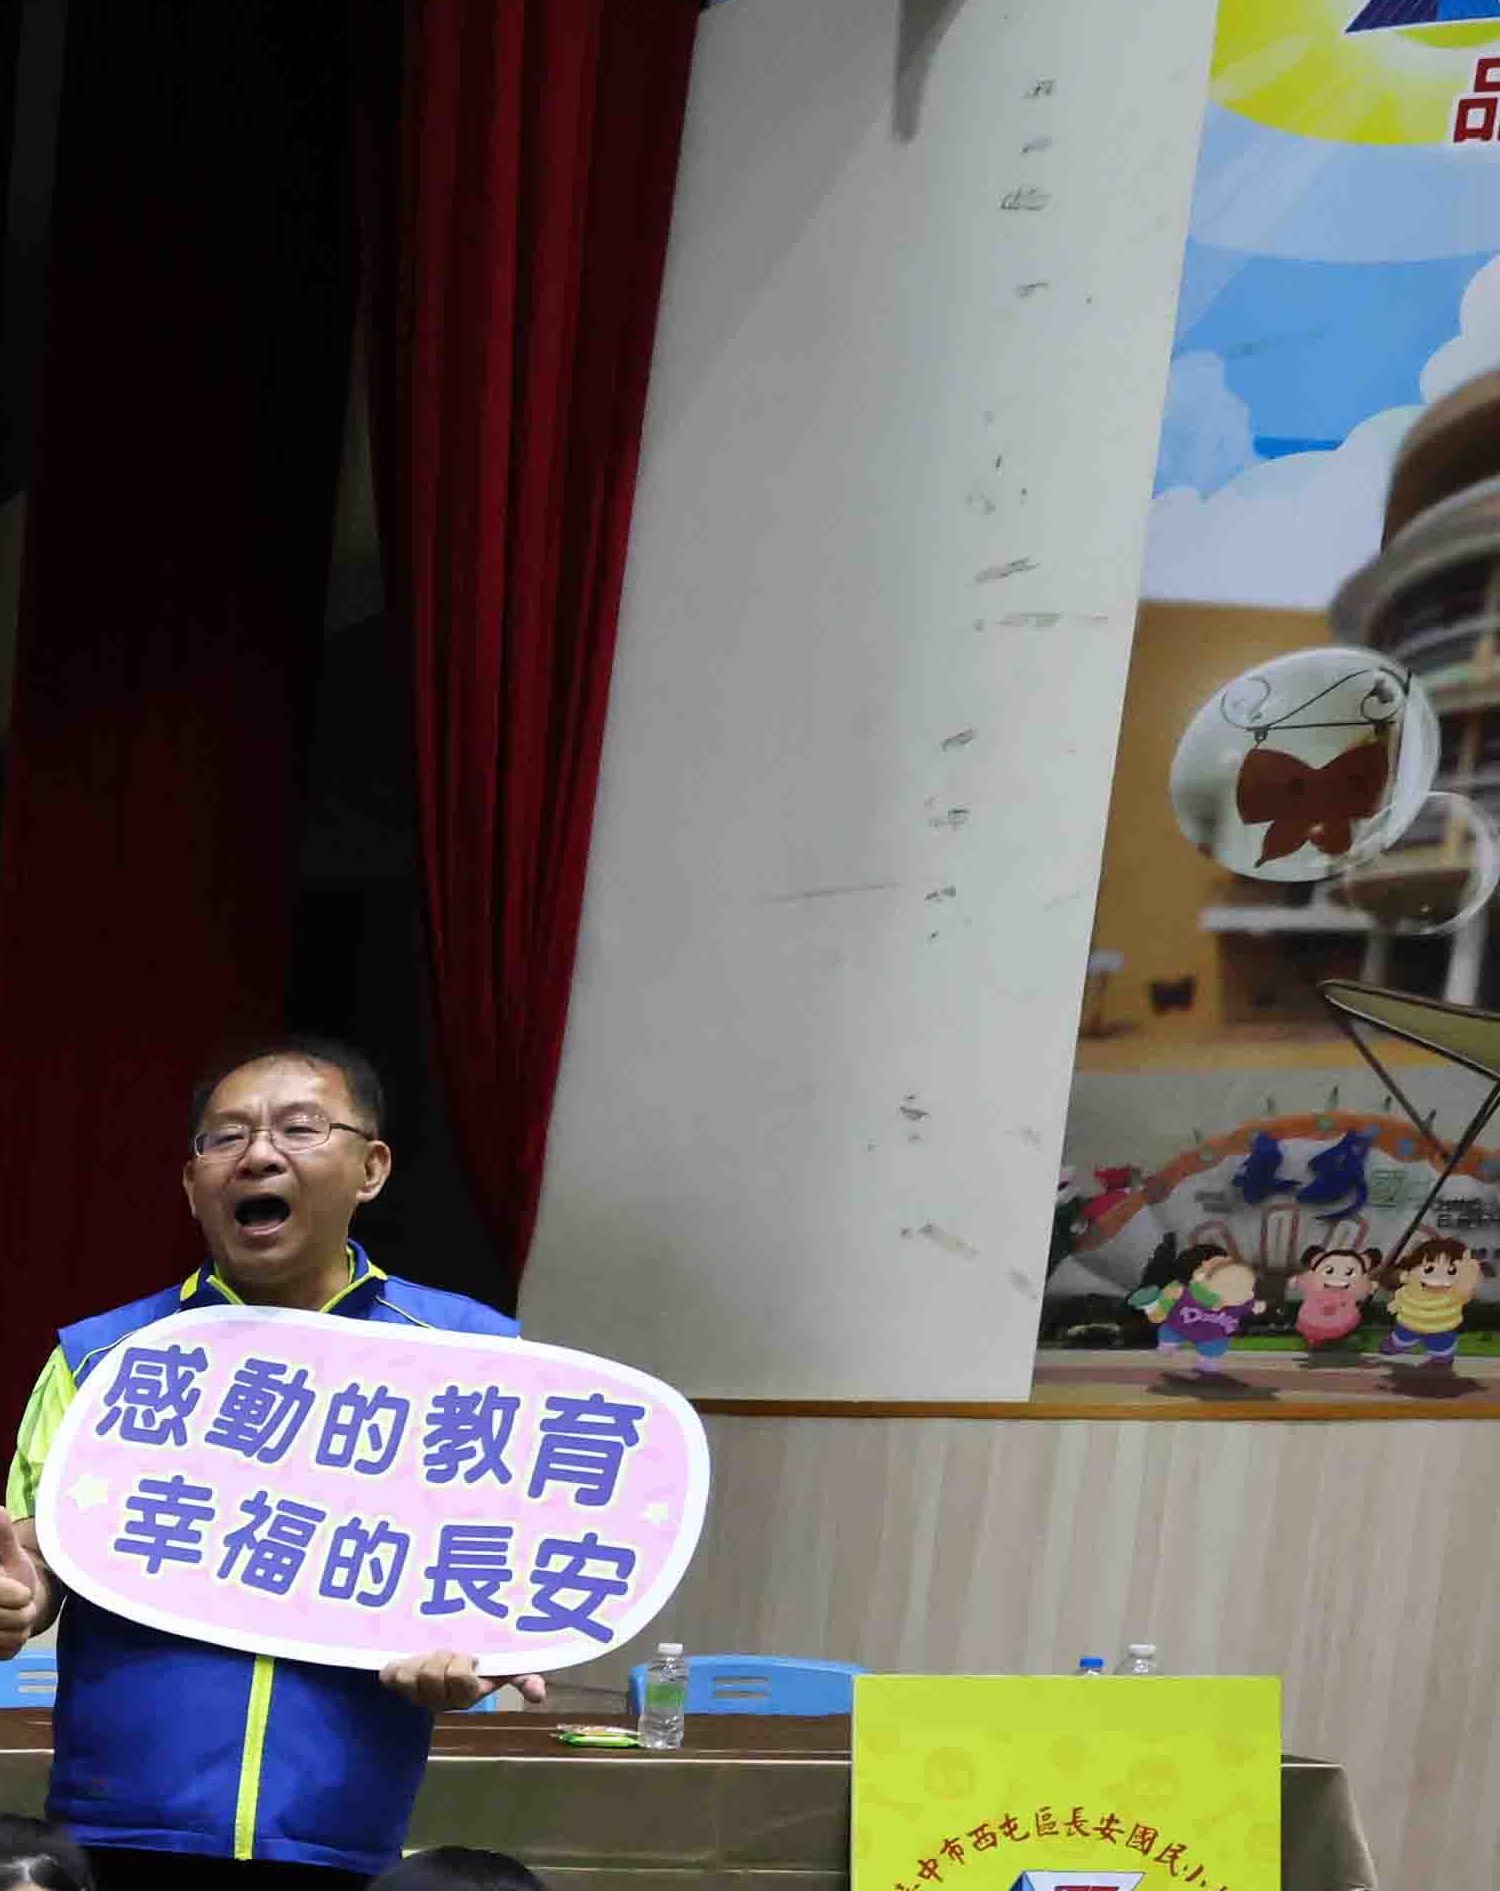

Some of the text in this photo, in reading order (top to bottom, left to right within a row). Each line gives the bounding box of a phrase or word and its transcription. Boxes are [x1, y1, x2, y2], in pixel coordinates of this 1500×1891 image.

[95, 1343, 646, 1506] 感動的教育
[113, 1475, 637, 1644] 幸福的長安
